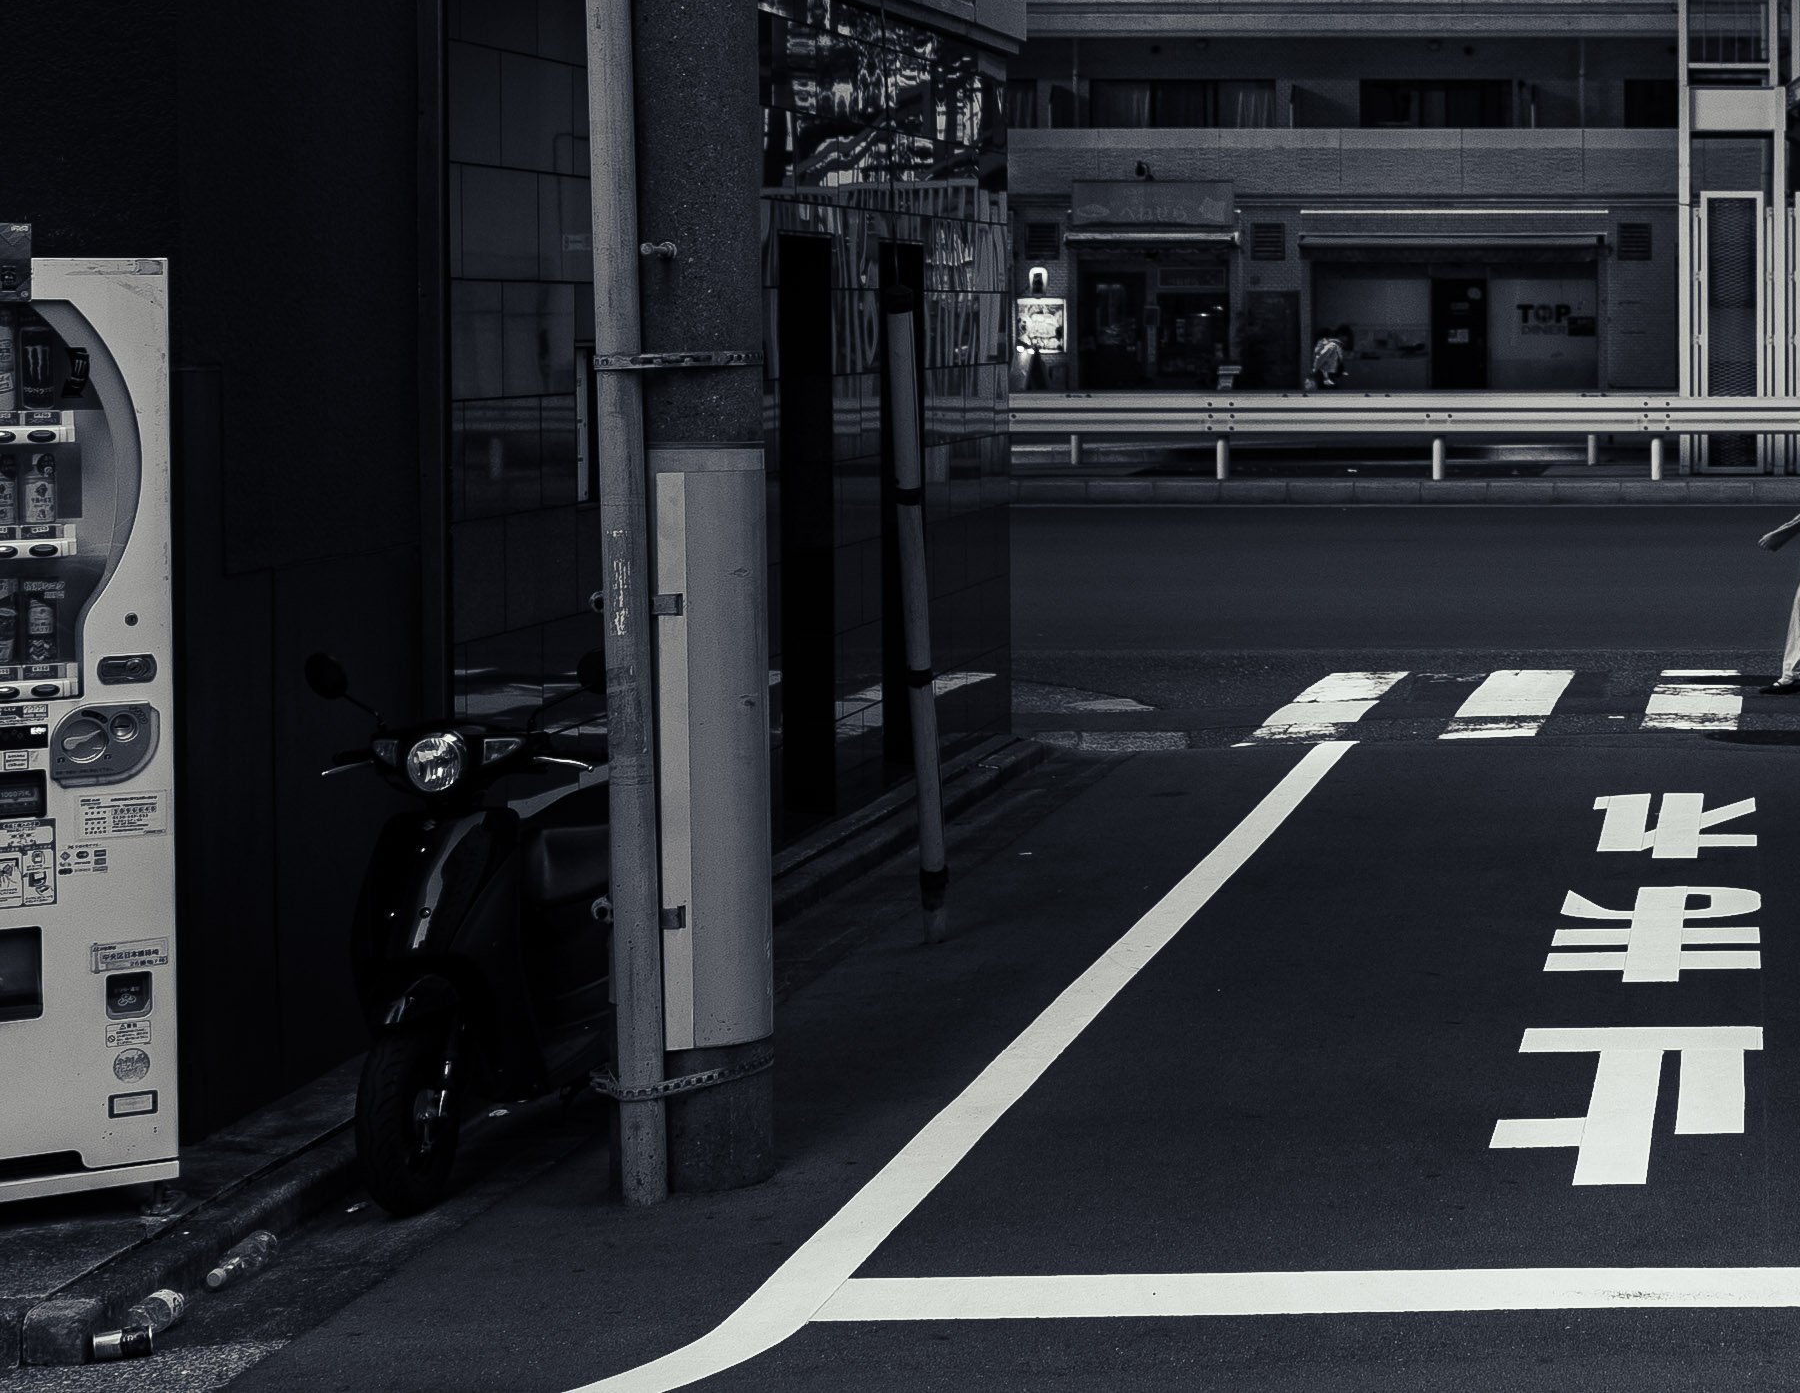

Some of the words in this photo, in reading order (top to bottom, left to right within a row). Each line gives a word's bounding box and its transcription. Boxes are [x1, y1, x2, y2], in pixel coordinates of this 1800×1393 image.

[1516, 303, 1571, 323] TOP
[1489, 792, 1764, 1186] 止まれ
